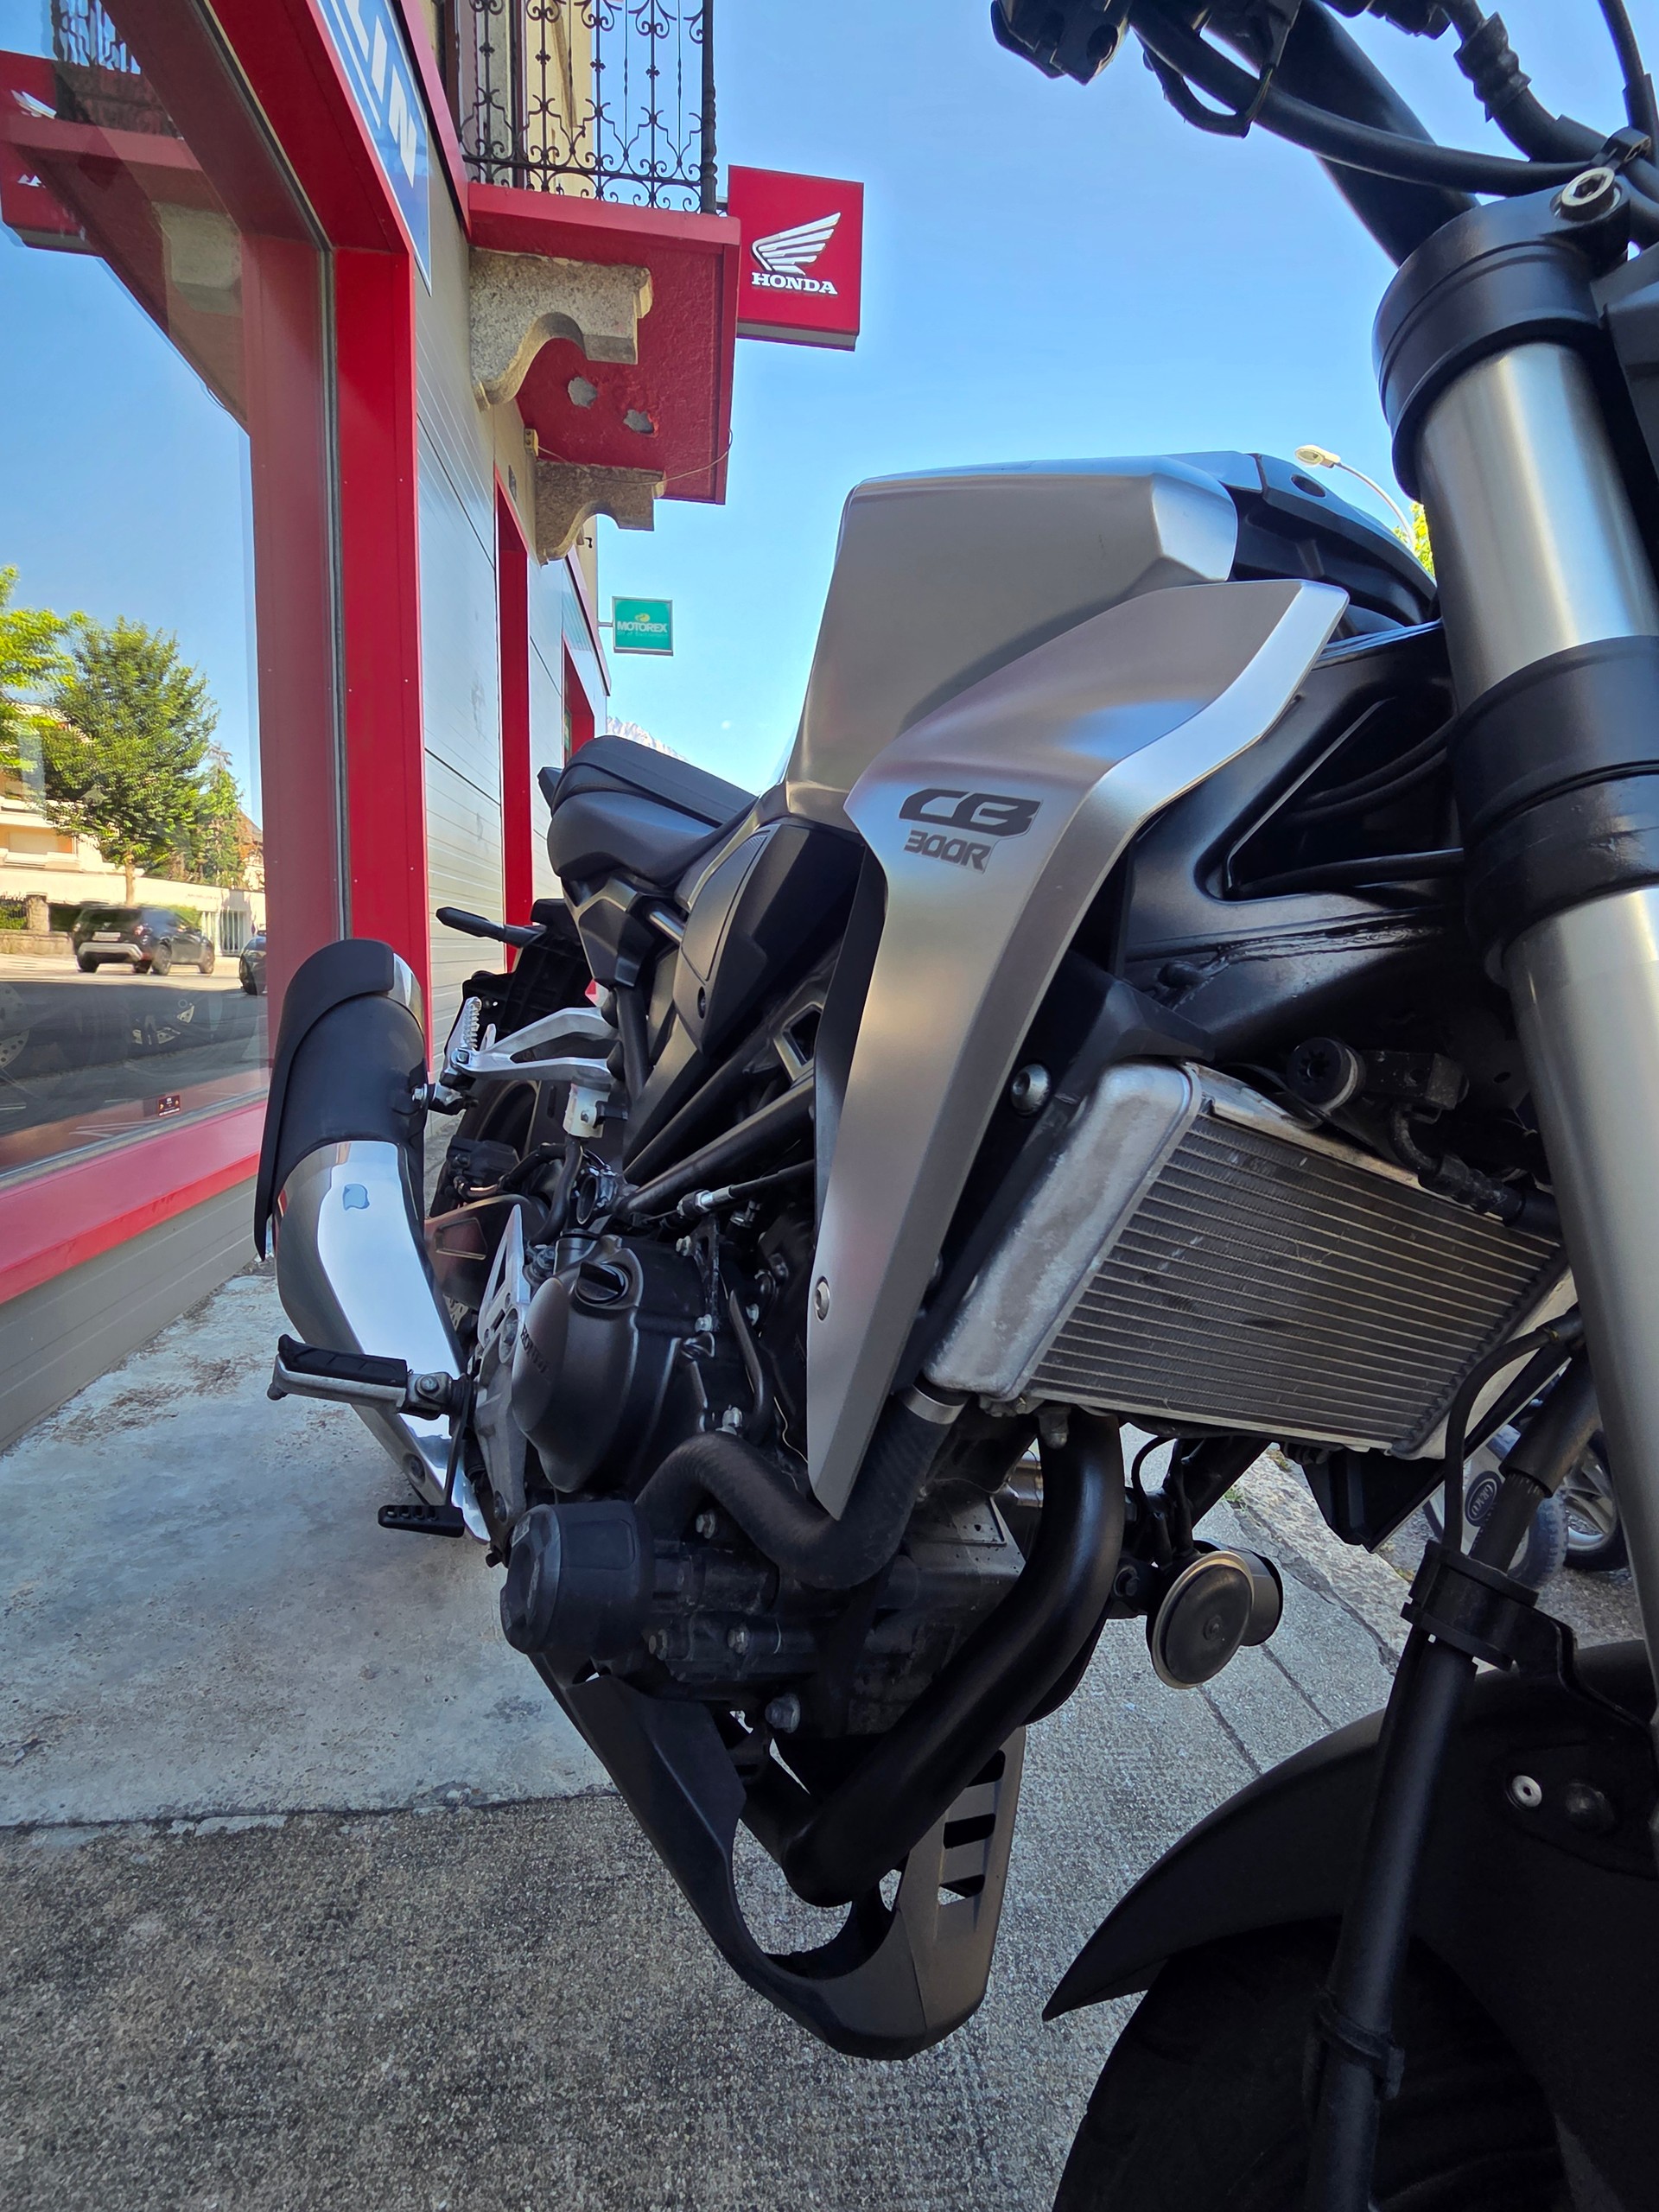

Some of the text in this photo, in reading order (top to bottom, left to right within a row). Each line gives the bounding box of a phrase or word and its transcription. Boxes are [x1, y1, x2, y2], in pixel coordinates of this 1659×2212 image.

[752, 272, 838, 295] HONDA
[617, 621, 667, 632] MOTOREX
[899, 788, 1040, 836] CB
[904, 830, 991, 872] 300R
